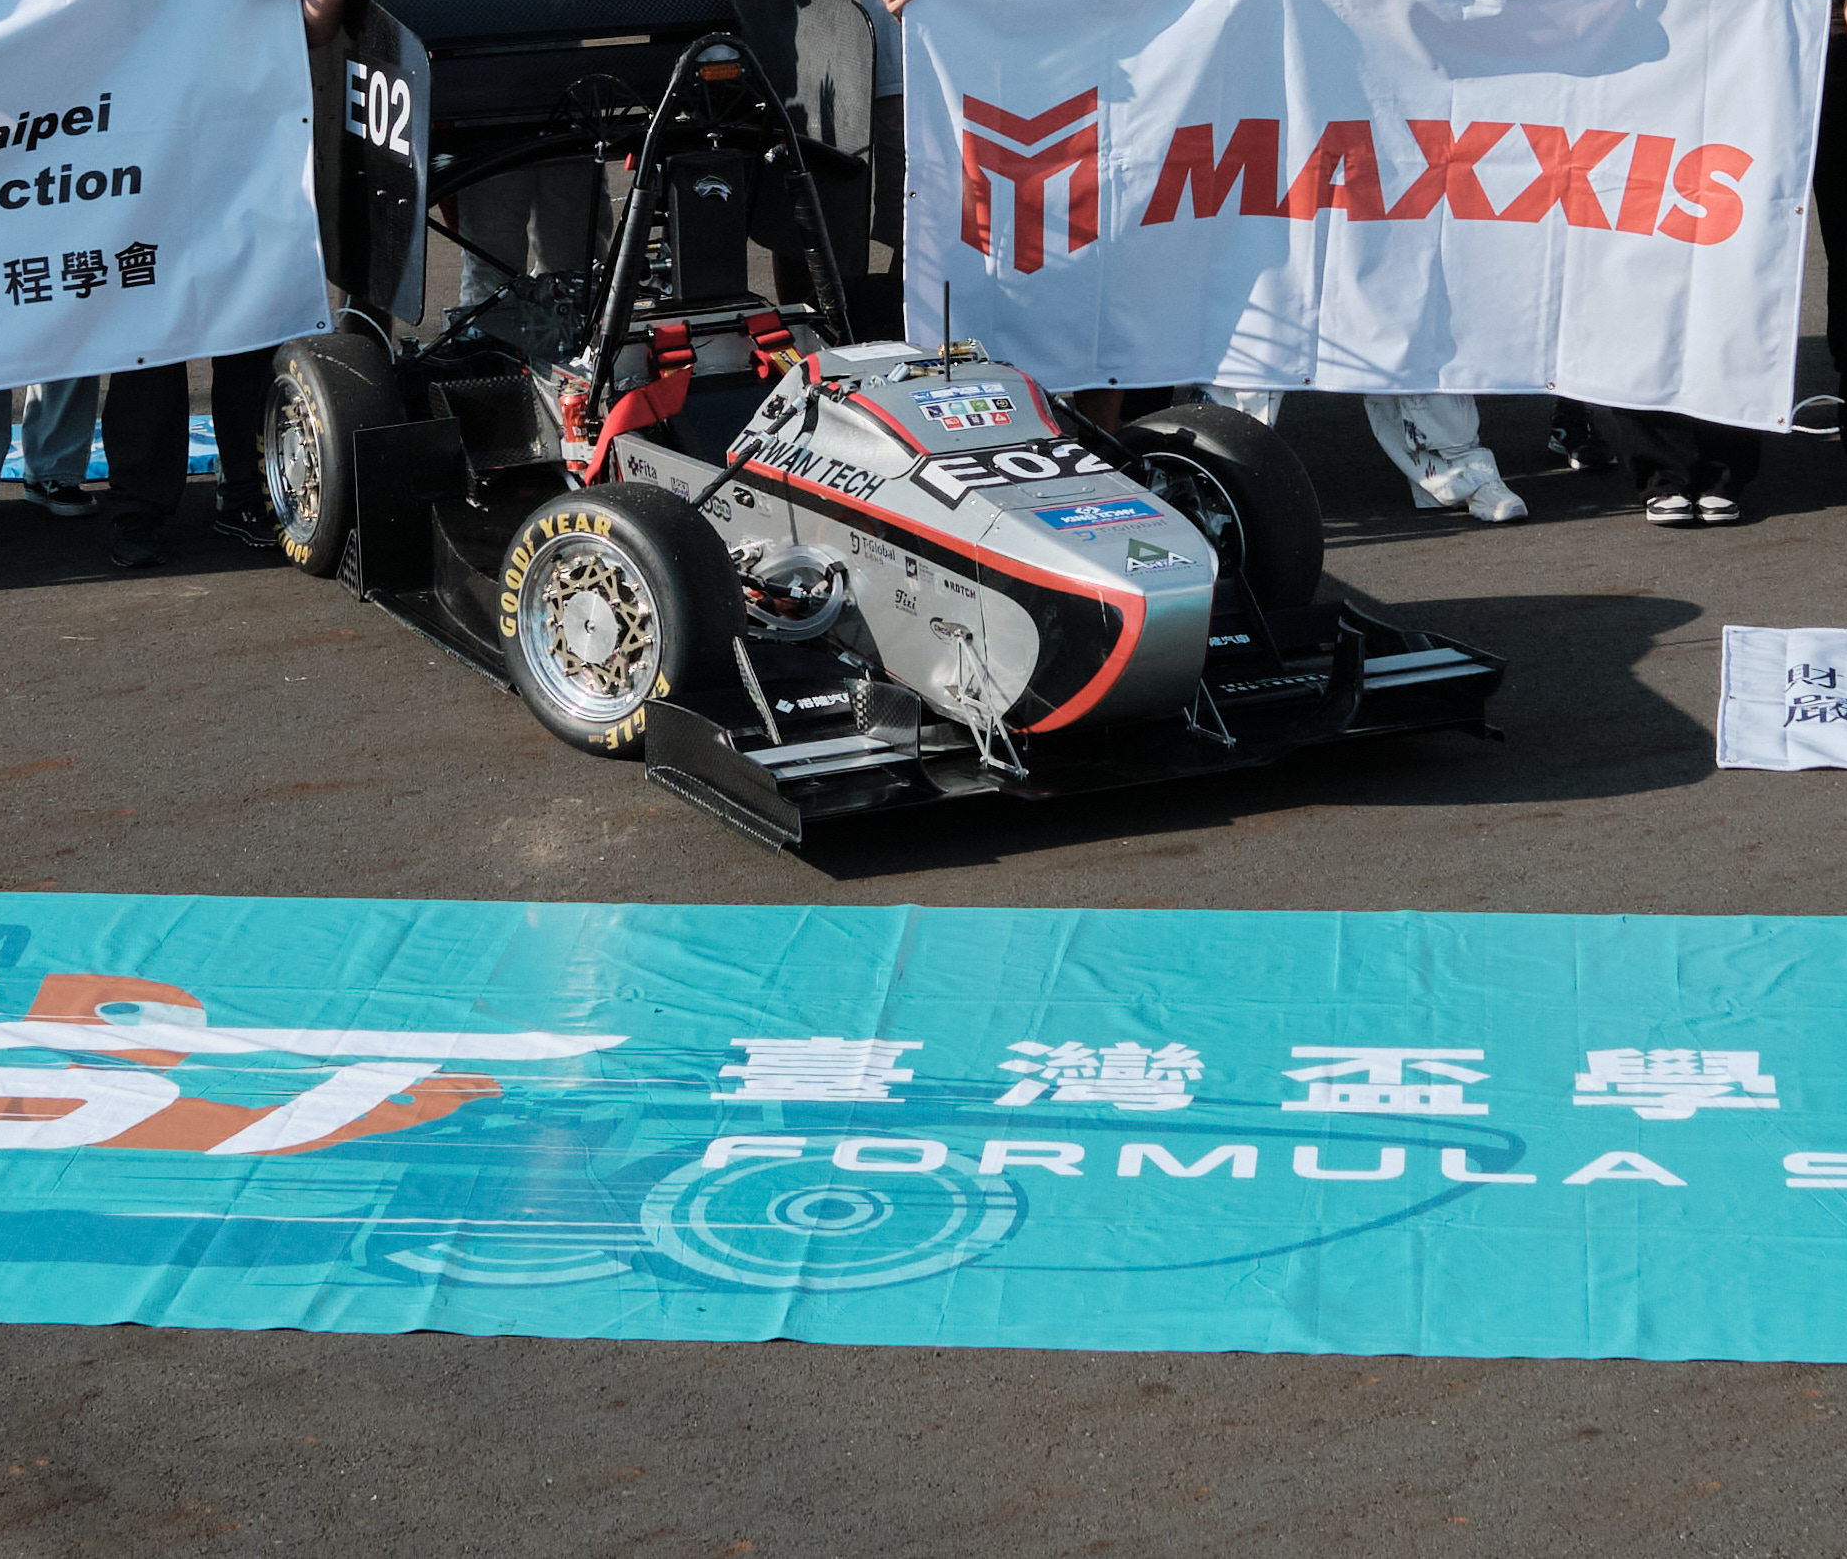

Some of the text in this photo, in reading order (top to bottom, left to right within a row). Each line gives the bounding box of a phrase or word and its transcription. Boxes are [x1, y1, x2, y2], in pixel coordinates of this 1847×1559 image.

[346, 59, 411, 156] E02
[1140, 118, 1754, 245] MAXXIS
[736, 429, 887, 500] TIWAN TECH
[919, 443, 1114, 500] E02
[500, 512, 612, 637] GOODYEAR
[603, 670, 671, 750] EGLE
[700, 1132, 1690, 1186] FORMULA
